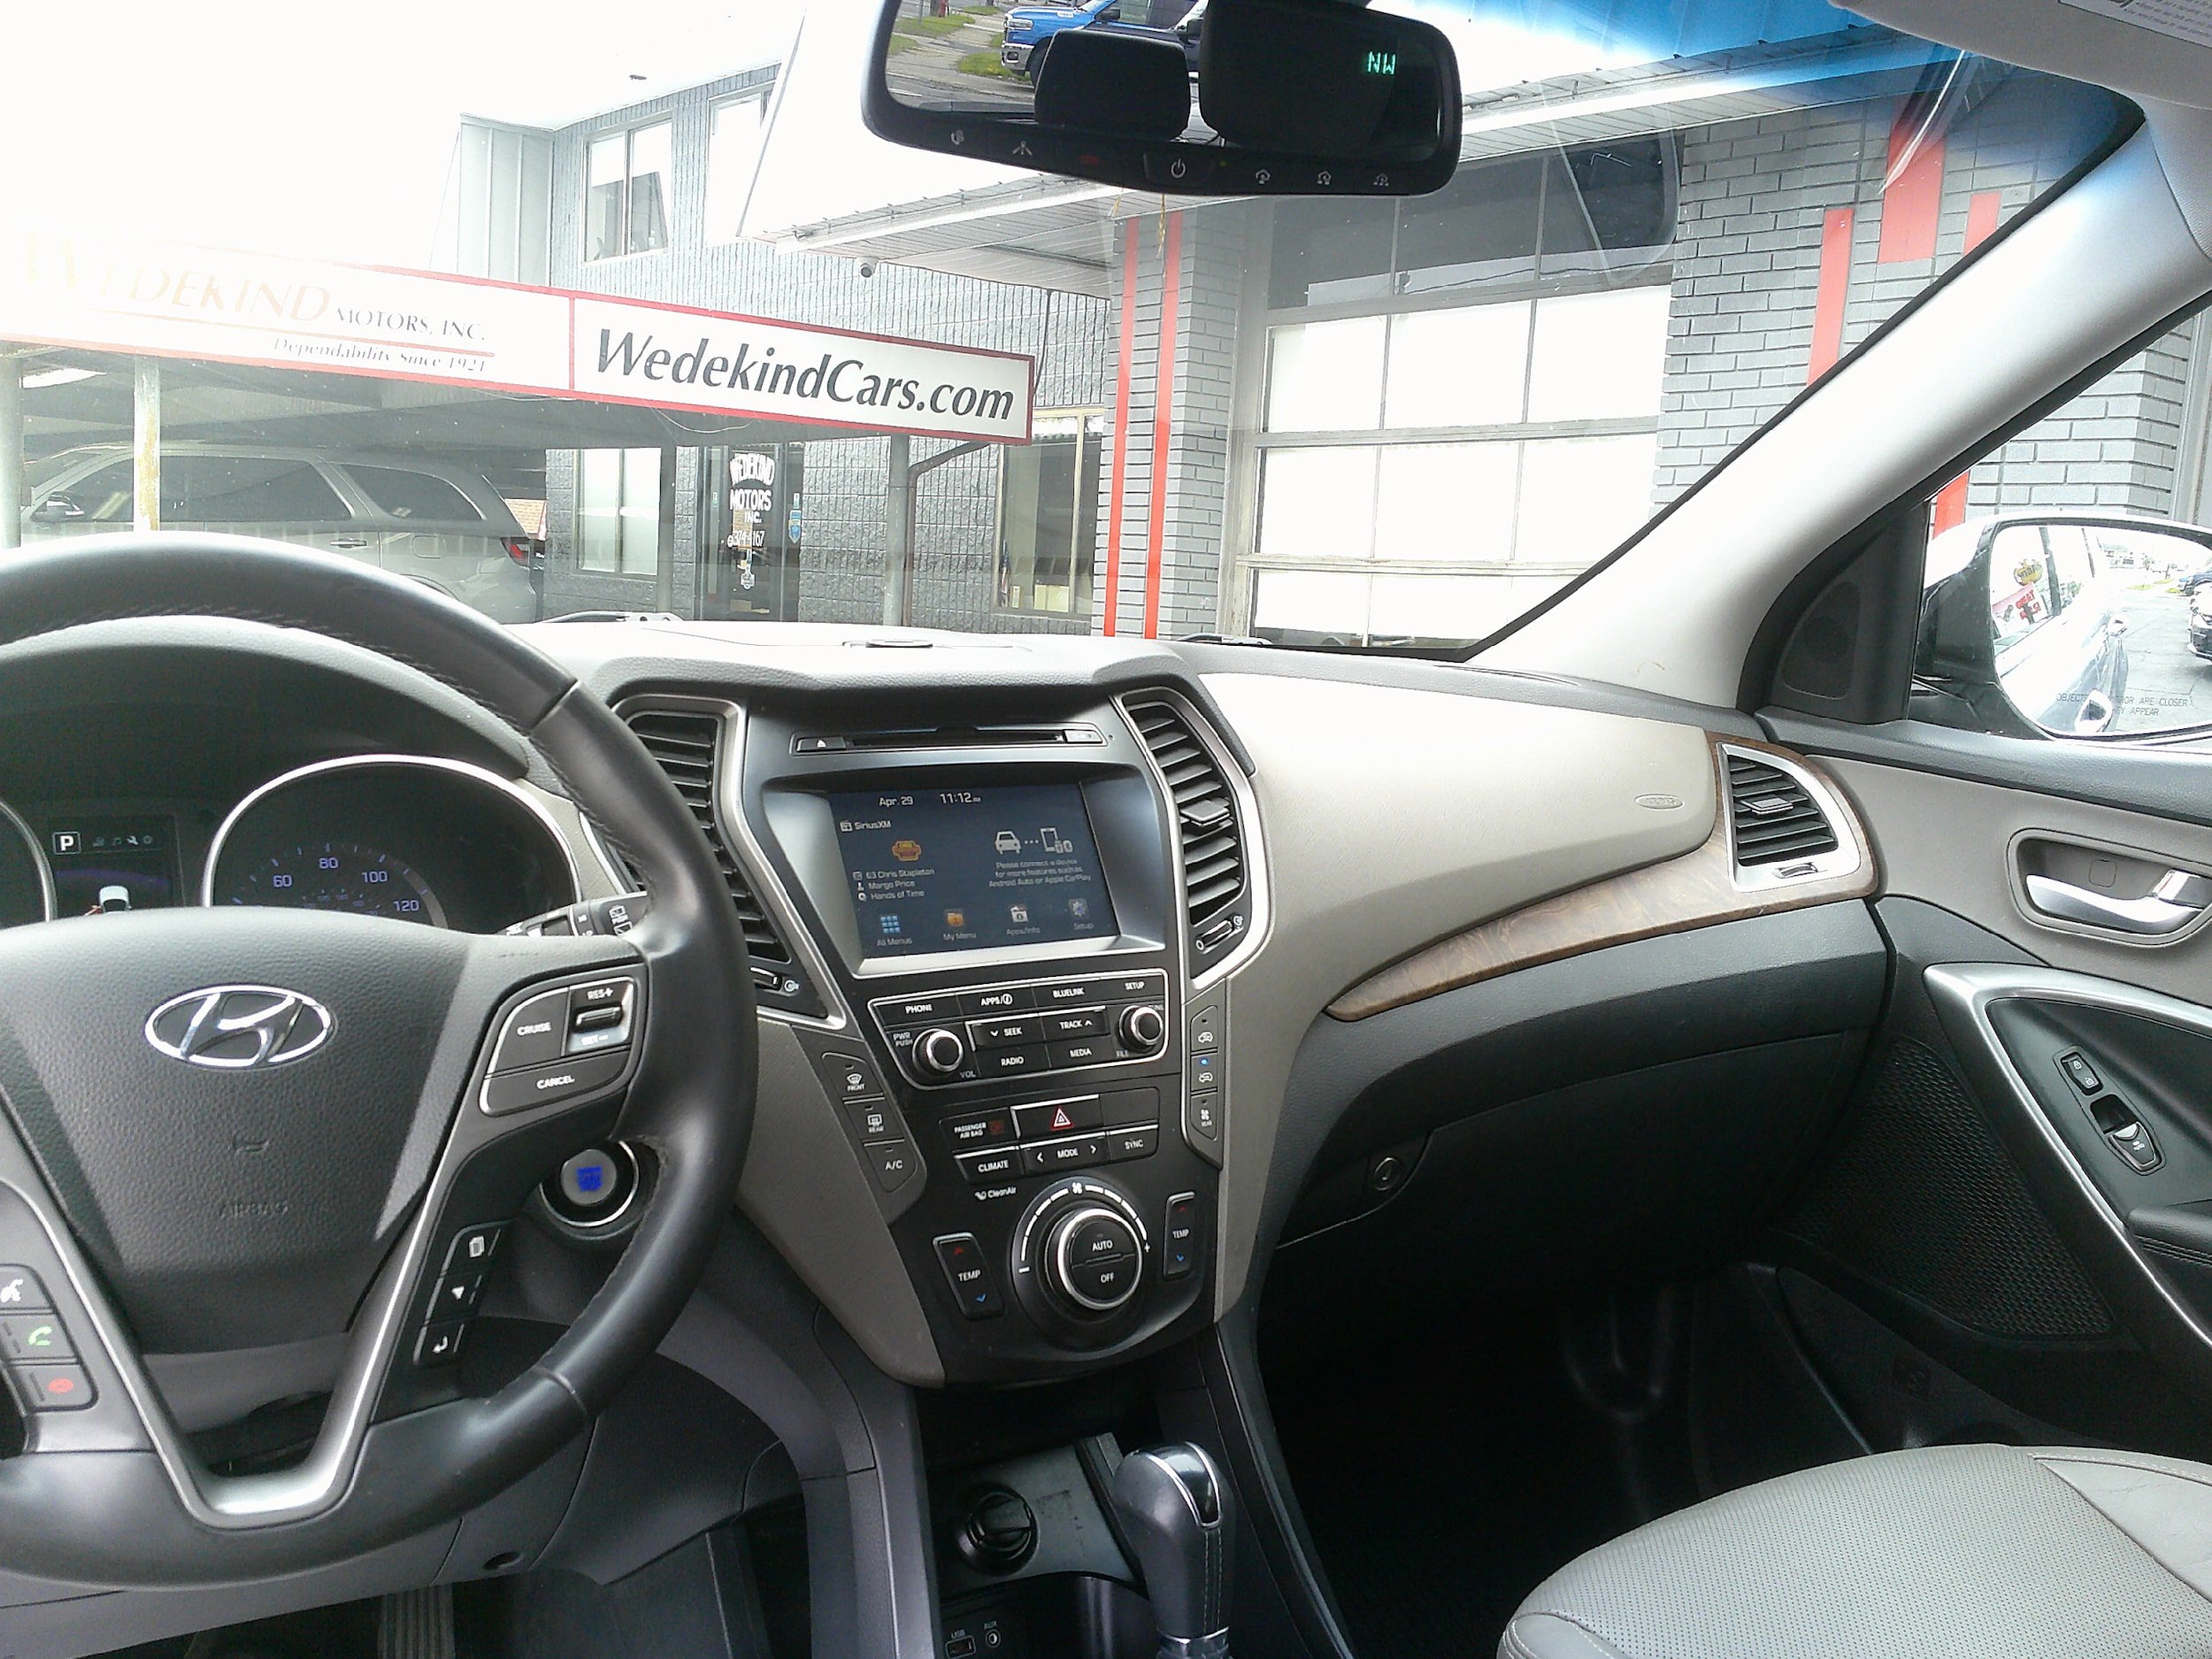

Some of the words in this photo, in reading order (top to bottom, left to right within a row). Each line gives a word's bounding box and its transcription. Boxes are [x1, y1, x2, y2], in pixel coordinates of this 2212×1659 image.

[1368, 51, 1395, 74] NW
[442, 320, 485, 340] INC.
[597, 328, 1014, 420] WedekindCars.com
[729, 453, 775, 486] WEDEKIND
[729, 488, 772, 511] MOTORS
[744, 511, 762, 523] INC.
[2158, 698, 2188, 707] CLOSER
[2130, 707, 2159, 716] APPEAR
[901, 796, 913, 805] 29
[940, 793, 972, 803] 11:12
[60, 835, 74, 850] P
[319, 857, 339, 869] 80
[273, 874, 292, 887] 60
[361, 871, 388, 883] 100
[394, 899, 420, 912] 120
[1125, 981, 1145, 990] SETUP
[1053, 987, 1085, 998] BLUELINK
[905, 1003, 933, 1014] PHONE
[517, 1021, 552, 1036] CRUISE
[1059, 1020, 1082, 1030] TRACK
[893, 1032, 911, 1041] PWR
[1003, 1027, 1023, 1036] SEEK
[1070, 1048, 1093, 1057] MEDIA
[1001, 1056, 1025, 1066] RADIO
[959, 1070, 977, 1079] VOL
[536, 1075, 575, 1089] CANCEL
[954, 1121, 987, 1133] PASSENGER
[1124, 1140, 1144, 1150] SYNC
[1056, 1148, 1079, 1159] MODE
[885, 1160, 903, 1171] A/C
[978, 1159, 1009, 1173] CLIMATE
[1172, 1228, 1189, 1239] TEMP
[1092, 1240, 1113, 1251] AUTO
[957, 1268, 981, 1283] TEMP
[1100, 1272, 1115, 1284] OFF
